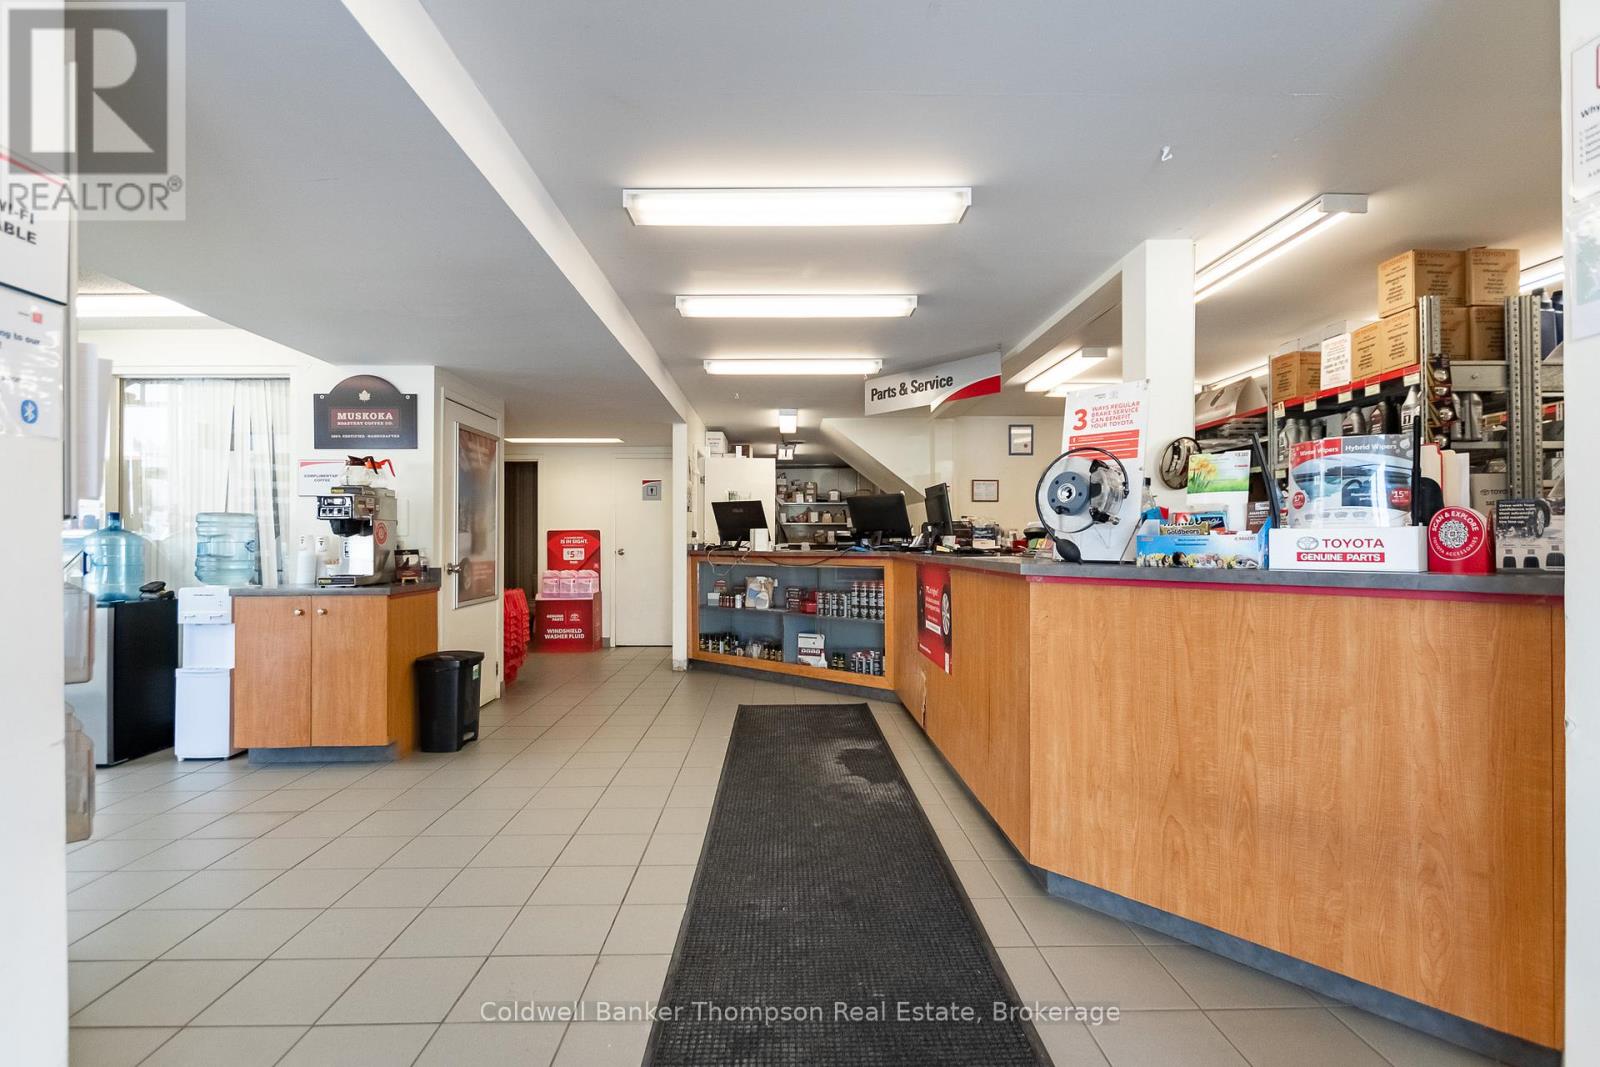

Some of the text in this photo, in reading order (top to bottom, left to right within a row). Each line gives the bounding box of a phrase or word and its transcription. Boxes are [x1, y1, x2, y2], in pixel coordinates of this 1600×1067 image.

[871, 376, 954, 401] Parts & Service
[337, 412, 393, 420] MUSKOKA
[1091, 407, 1139, 418] BRAKE SERVICE
[1073, 408, 1087, 431] 3
[1091, 413, 1131, 424] CAN BENEFIT
[1109, 419, 1134, 427] TOYOTA
[1345, 441, 1397, 452] Hybrid Wipers
[1432, 514, 1445, 531] SCAN
[1451, 511, 1479, 532] EXPLORE
[1322, 538, 1384, 549] TOYOTA
[1300, 553, 1381, 562] GENUINE PARTS
